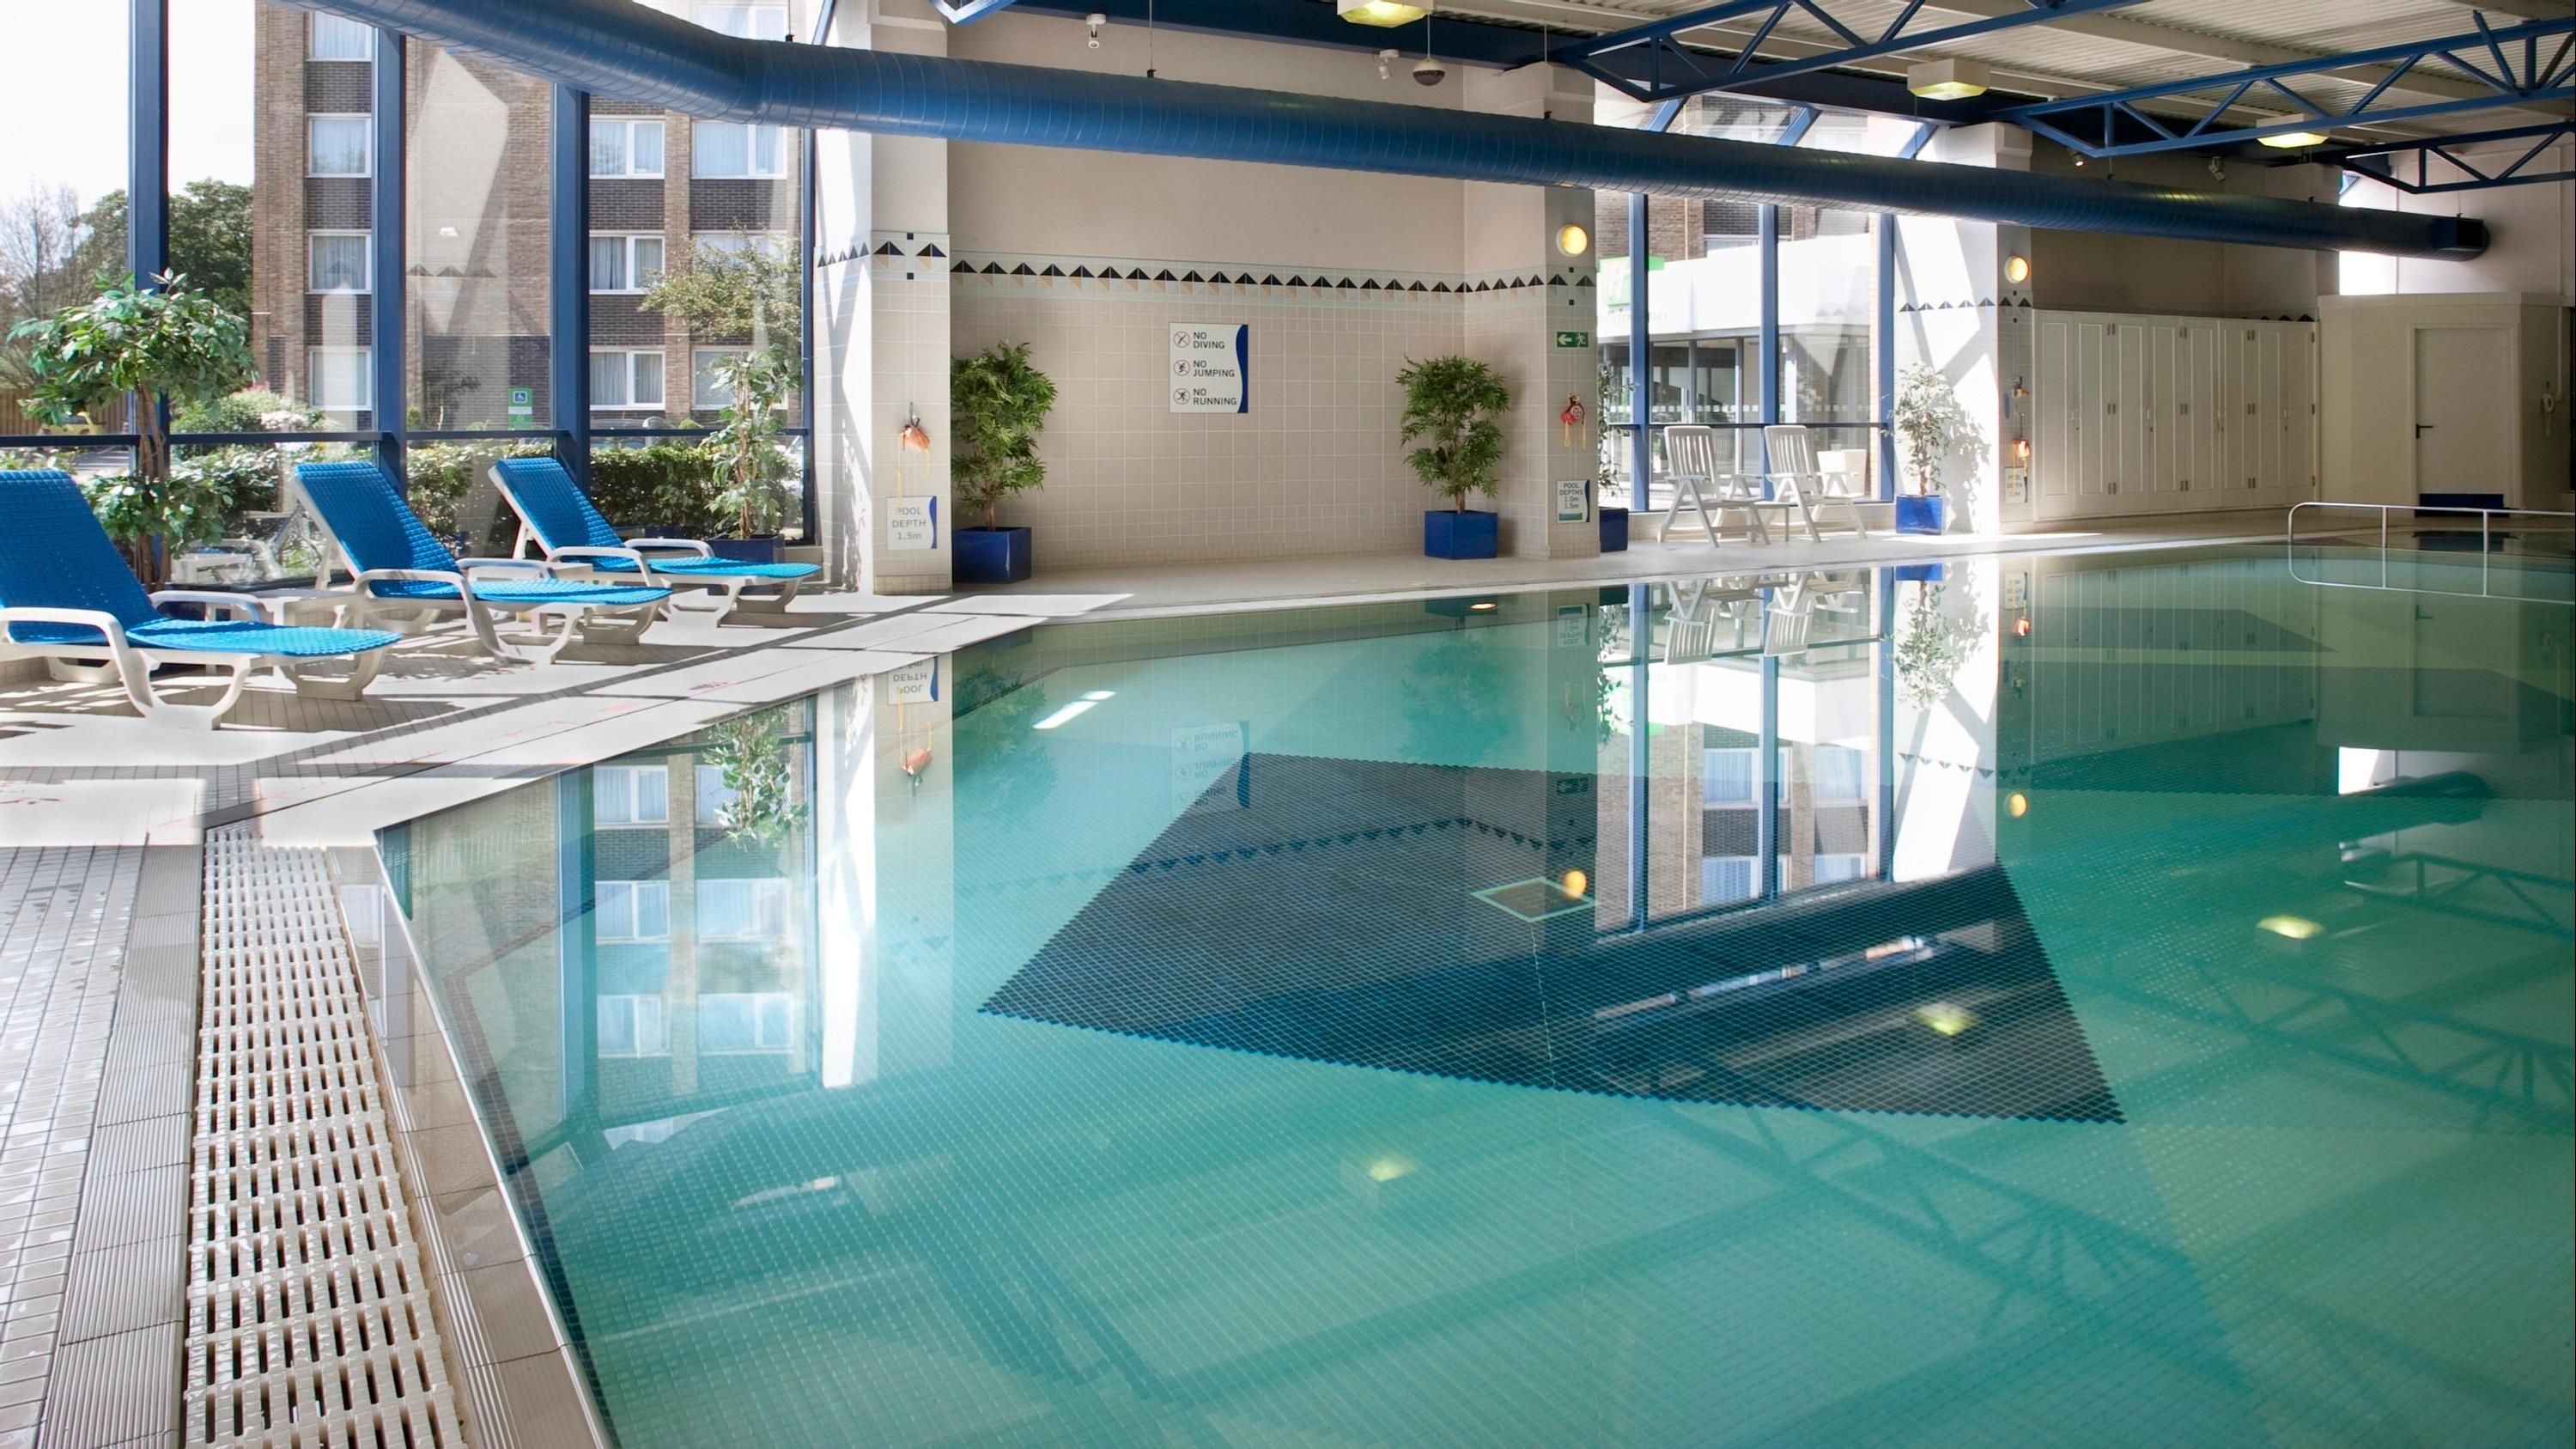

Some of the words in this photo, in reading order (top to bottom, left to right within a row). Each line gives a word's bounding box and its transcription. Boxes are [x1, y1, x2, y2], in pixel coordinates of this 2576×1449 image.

[1193, 332, 1207, 340] NO
[1193, 360, 1207, 368] NO
[1193, 369, 1235, 378] JUMPING
[891, 519, 927, 528] DEPTH
[897, 532, 921, 540] 1.5m
